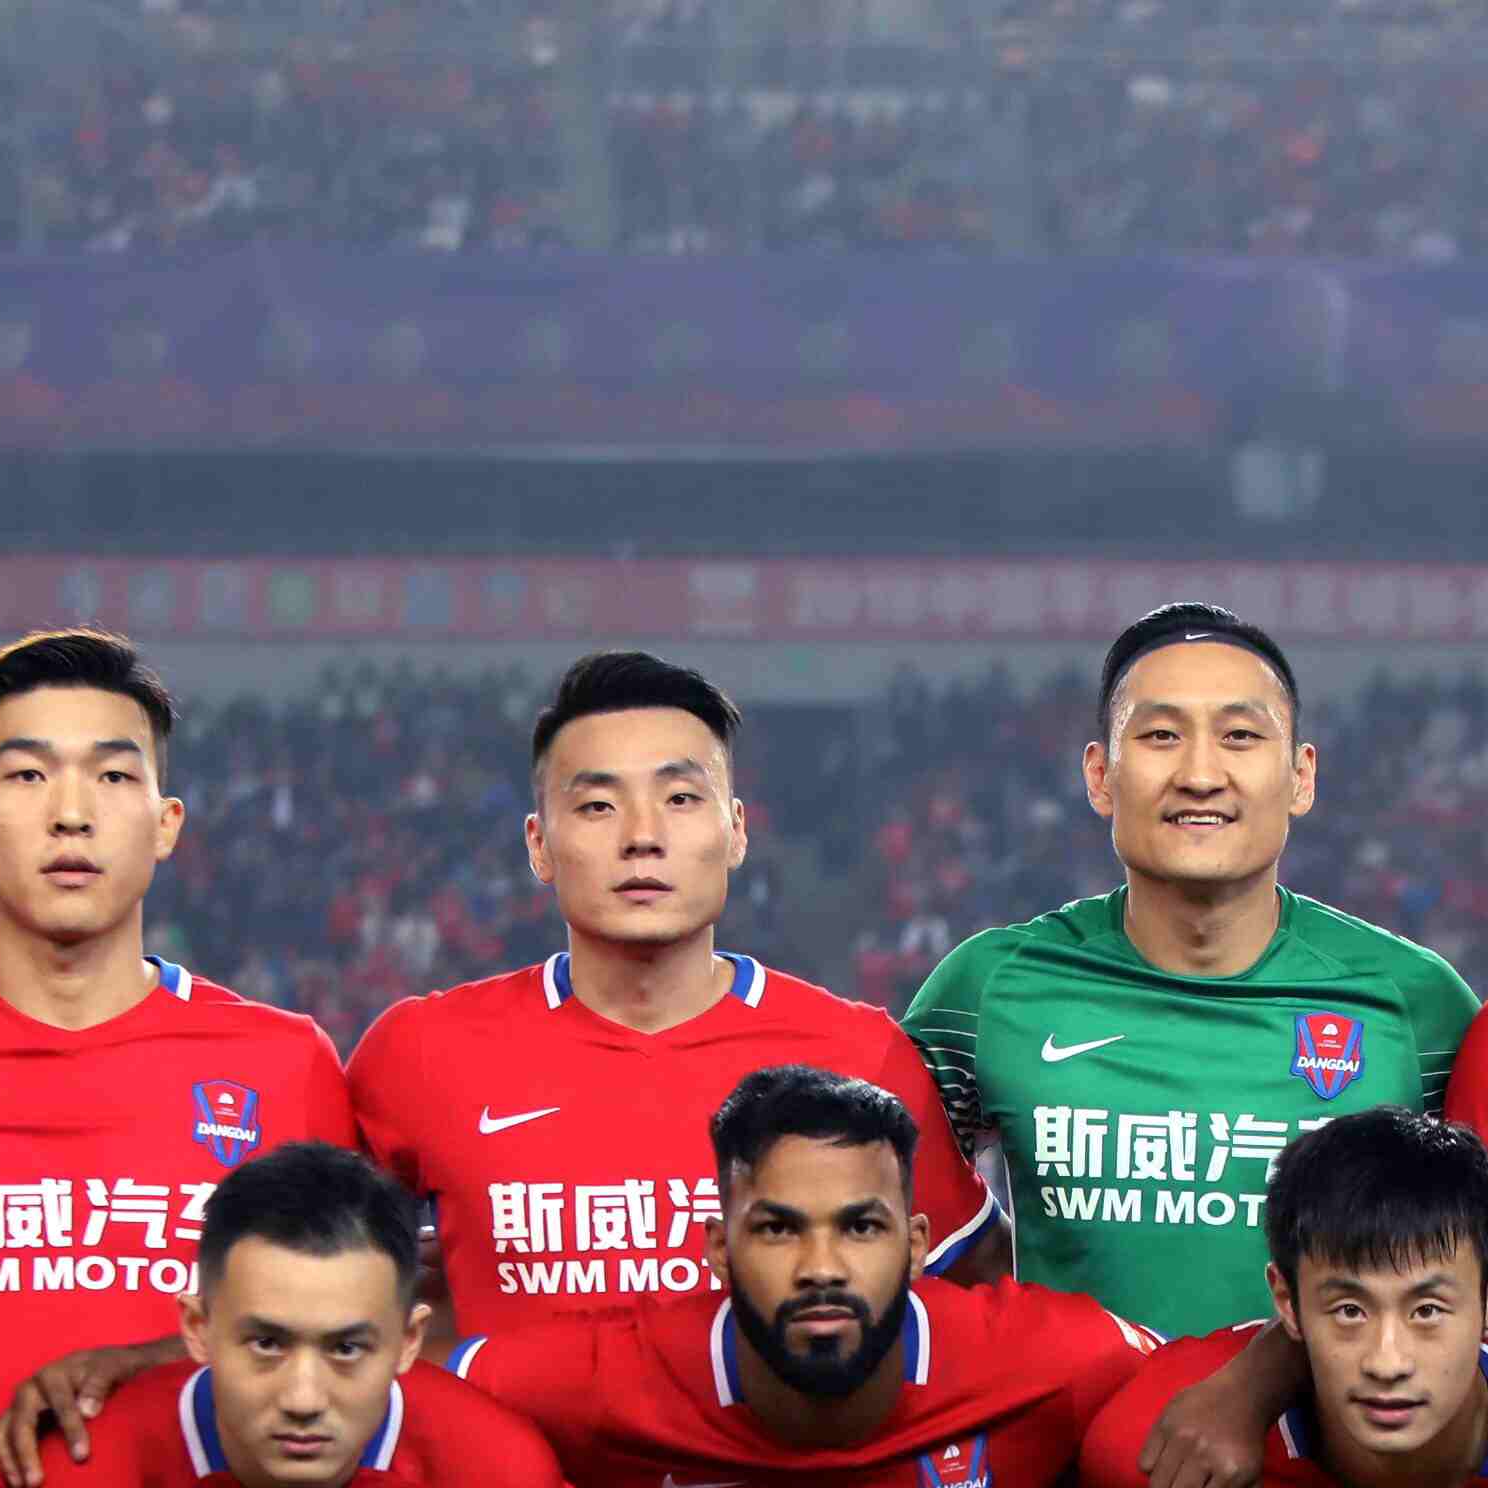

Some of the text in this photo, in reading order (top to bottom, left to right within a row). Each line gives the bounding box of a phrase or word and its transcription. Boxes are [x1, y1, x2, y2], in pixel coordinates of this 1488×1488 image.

[1296, 1054, 1360, 1073] DANGDAI
[197, 1121, 256, 1143] DANGDAI
[1033, 1106, 1328, 1182] 斯威汽
[488, 1178, 724, 1253] 斯威汽
[1041, 1187, 1142, 1221] SWM
[32, 1256, 200, 1295] MOTO
[497, 1259, 607, 1295] SWM
